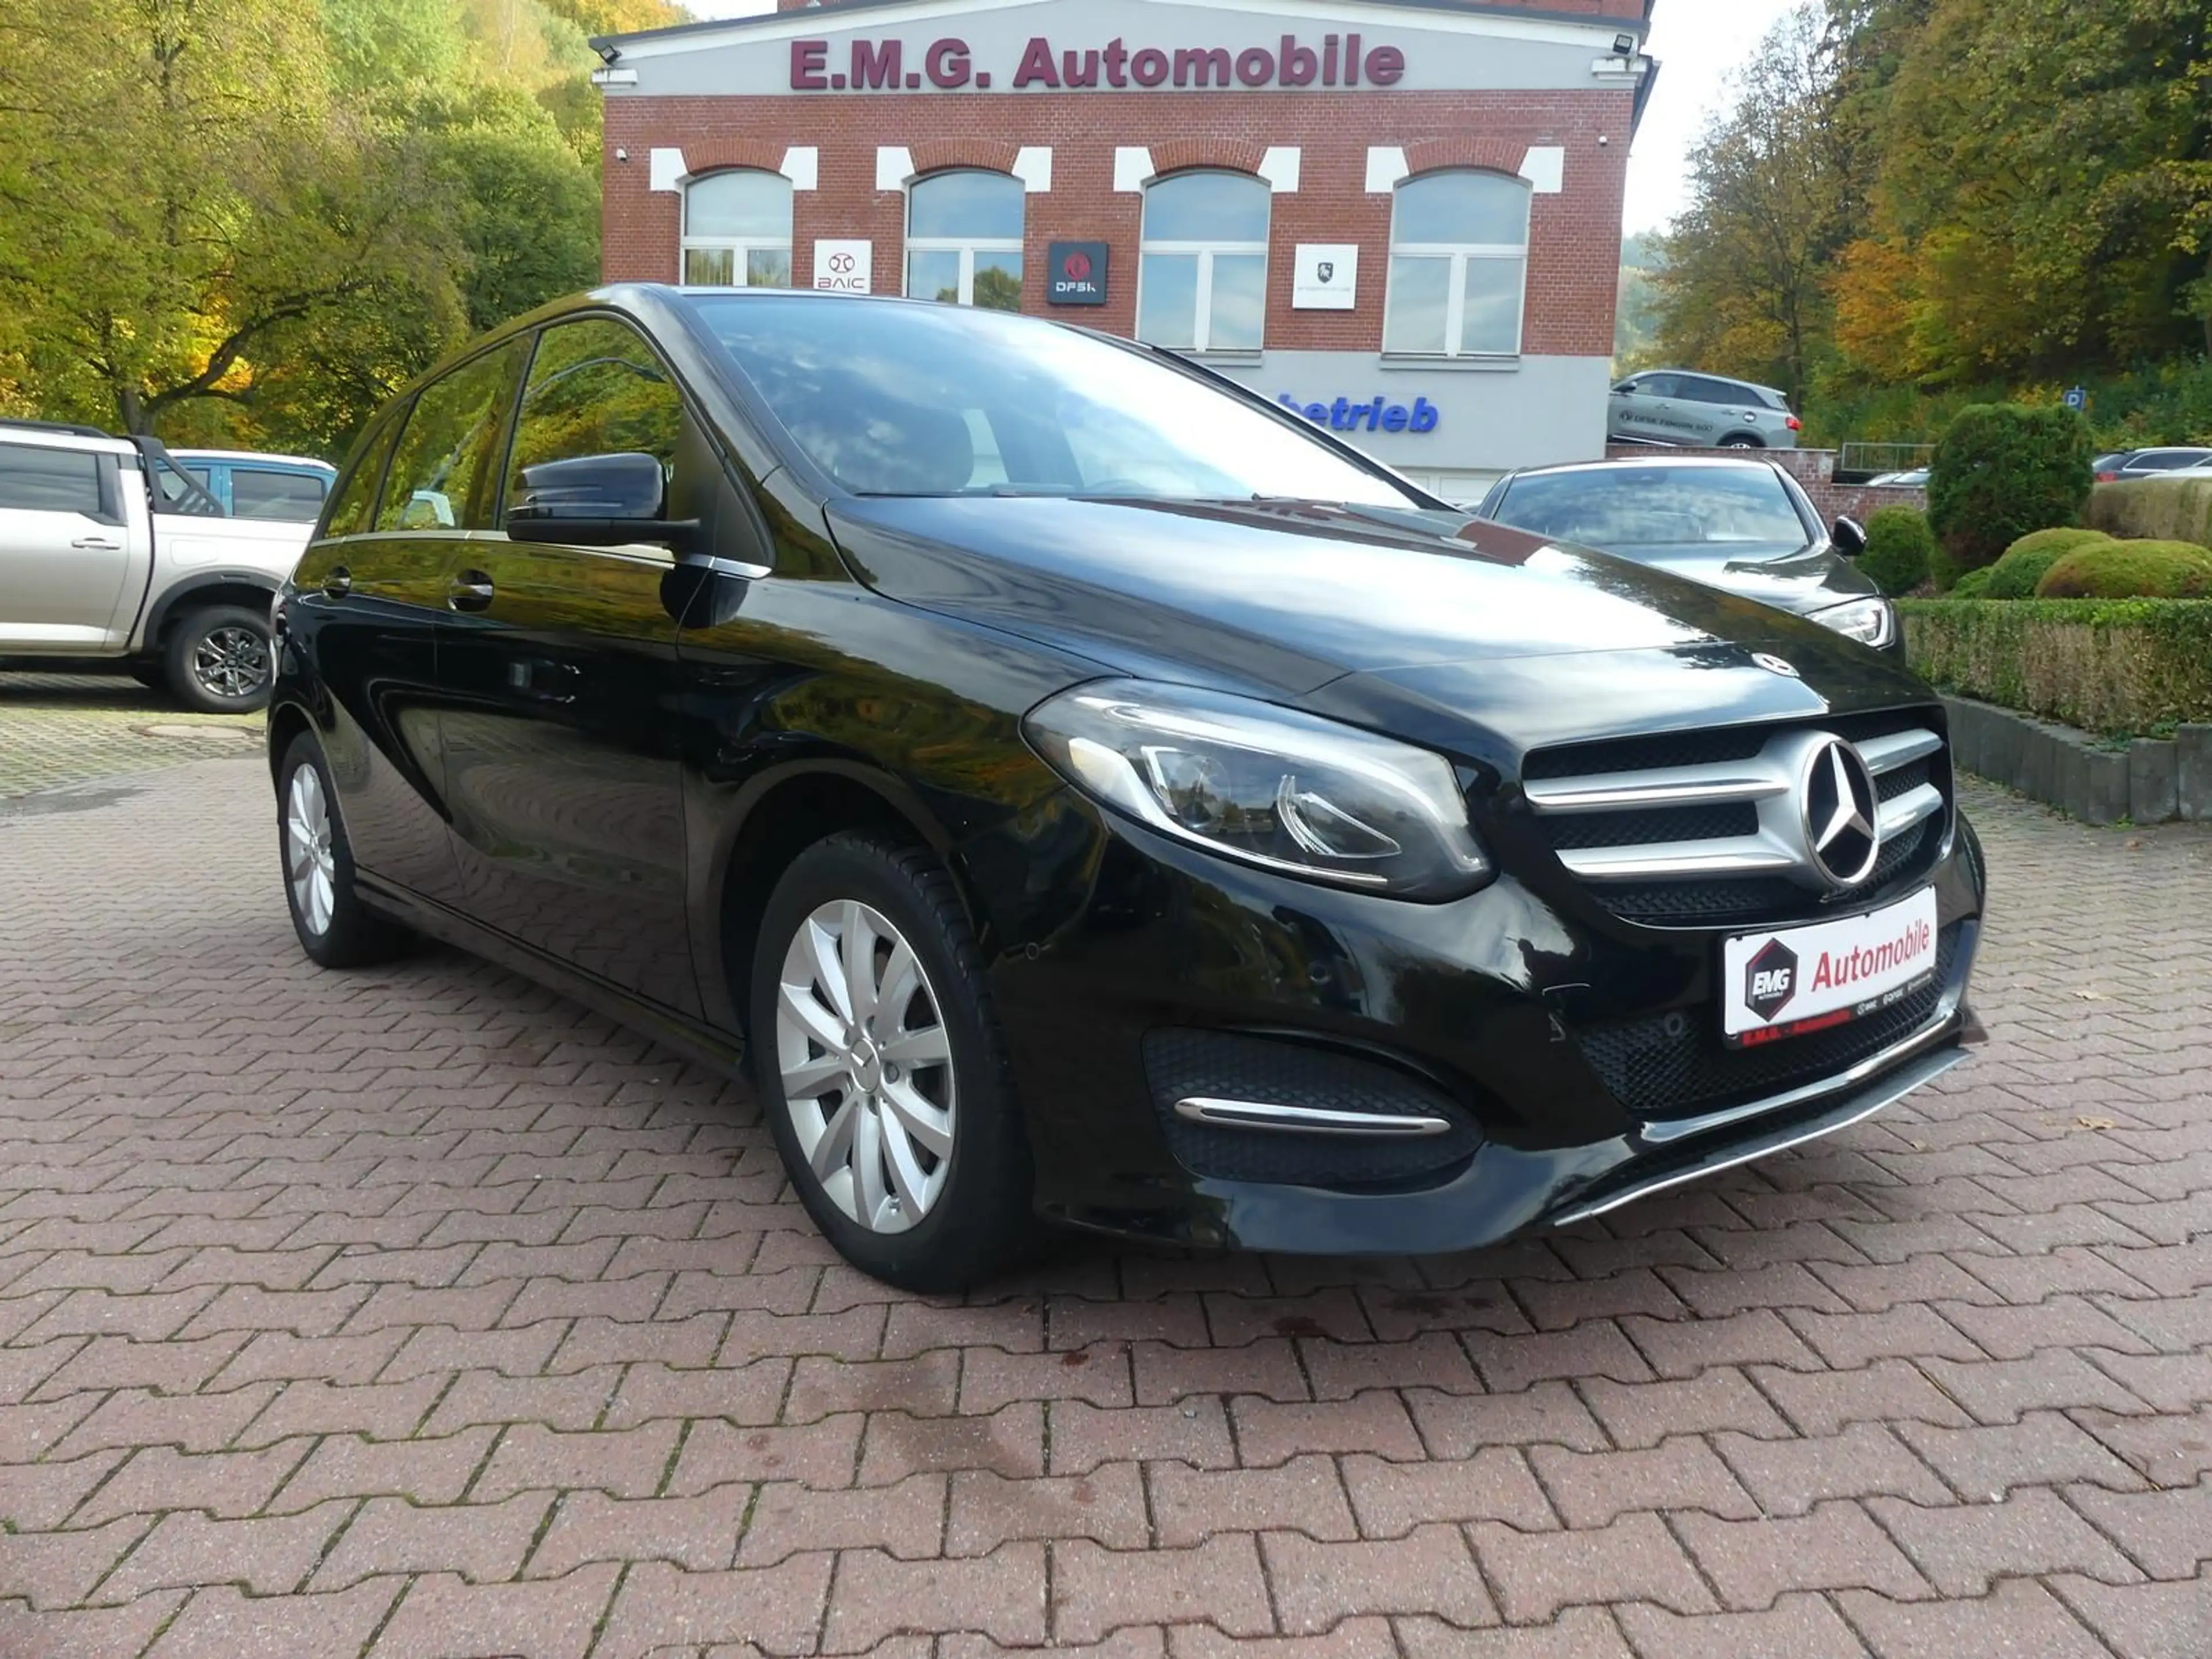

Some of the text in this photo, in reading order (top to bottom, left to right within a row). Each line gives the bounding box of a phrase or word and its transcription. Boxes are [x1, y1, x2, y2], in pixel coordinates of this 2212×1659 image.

[790, 33, 1406, 90] E.M.G. Automobile
[818, 277, 865, 288] BAIC
[1056, 281, 1096, 293] DFSK
[2067, 393, 2080, 406] P
[1811, 919, 1930, 993] Automobile
[1752, 968, 1791, 995] EMG
